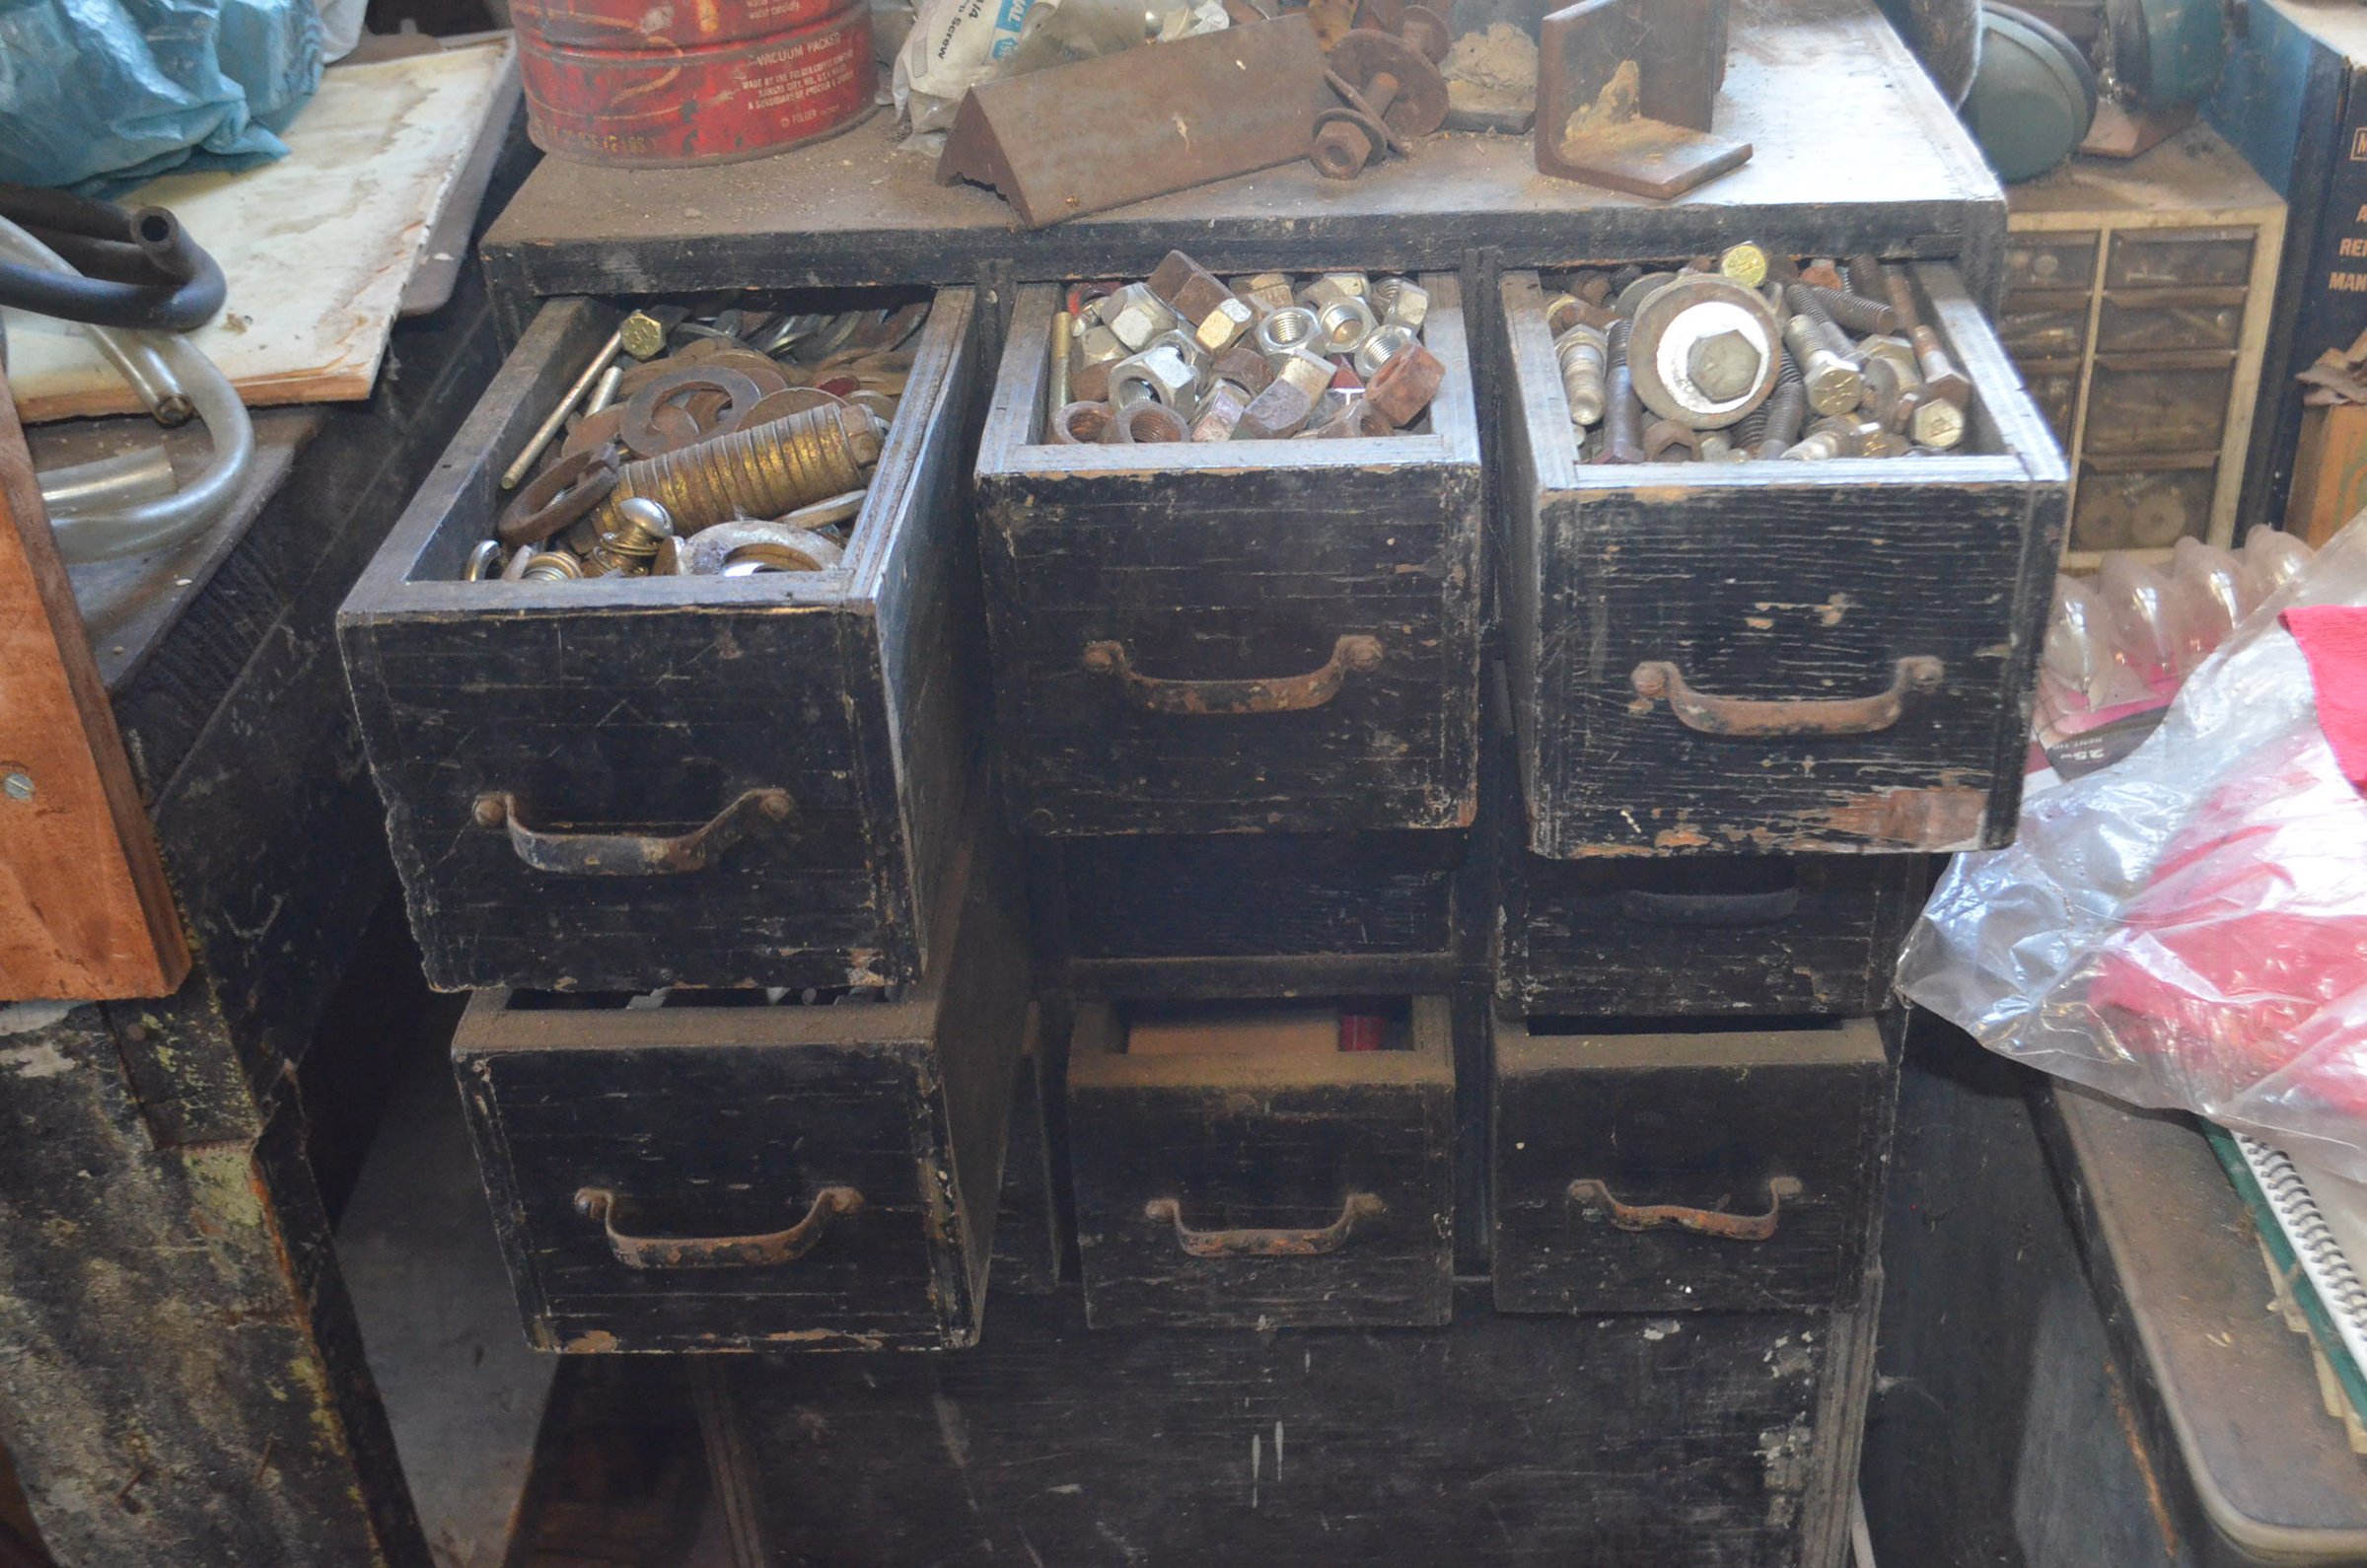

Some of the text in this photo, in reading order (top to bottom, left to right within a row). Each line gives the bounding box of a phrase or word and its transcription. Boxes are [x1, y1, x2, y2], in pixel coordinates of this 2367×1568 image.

[938, 17, 962, 59] Screw
[756, 32, 840, 66] VACUUM PACKED
[742, 78, 762, 90] MADE
[764, 76, 774, 86] BY
[758, 85, 785, 98] KANSAS
[748, 102, 754, 110] A
